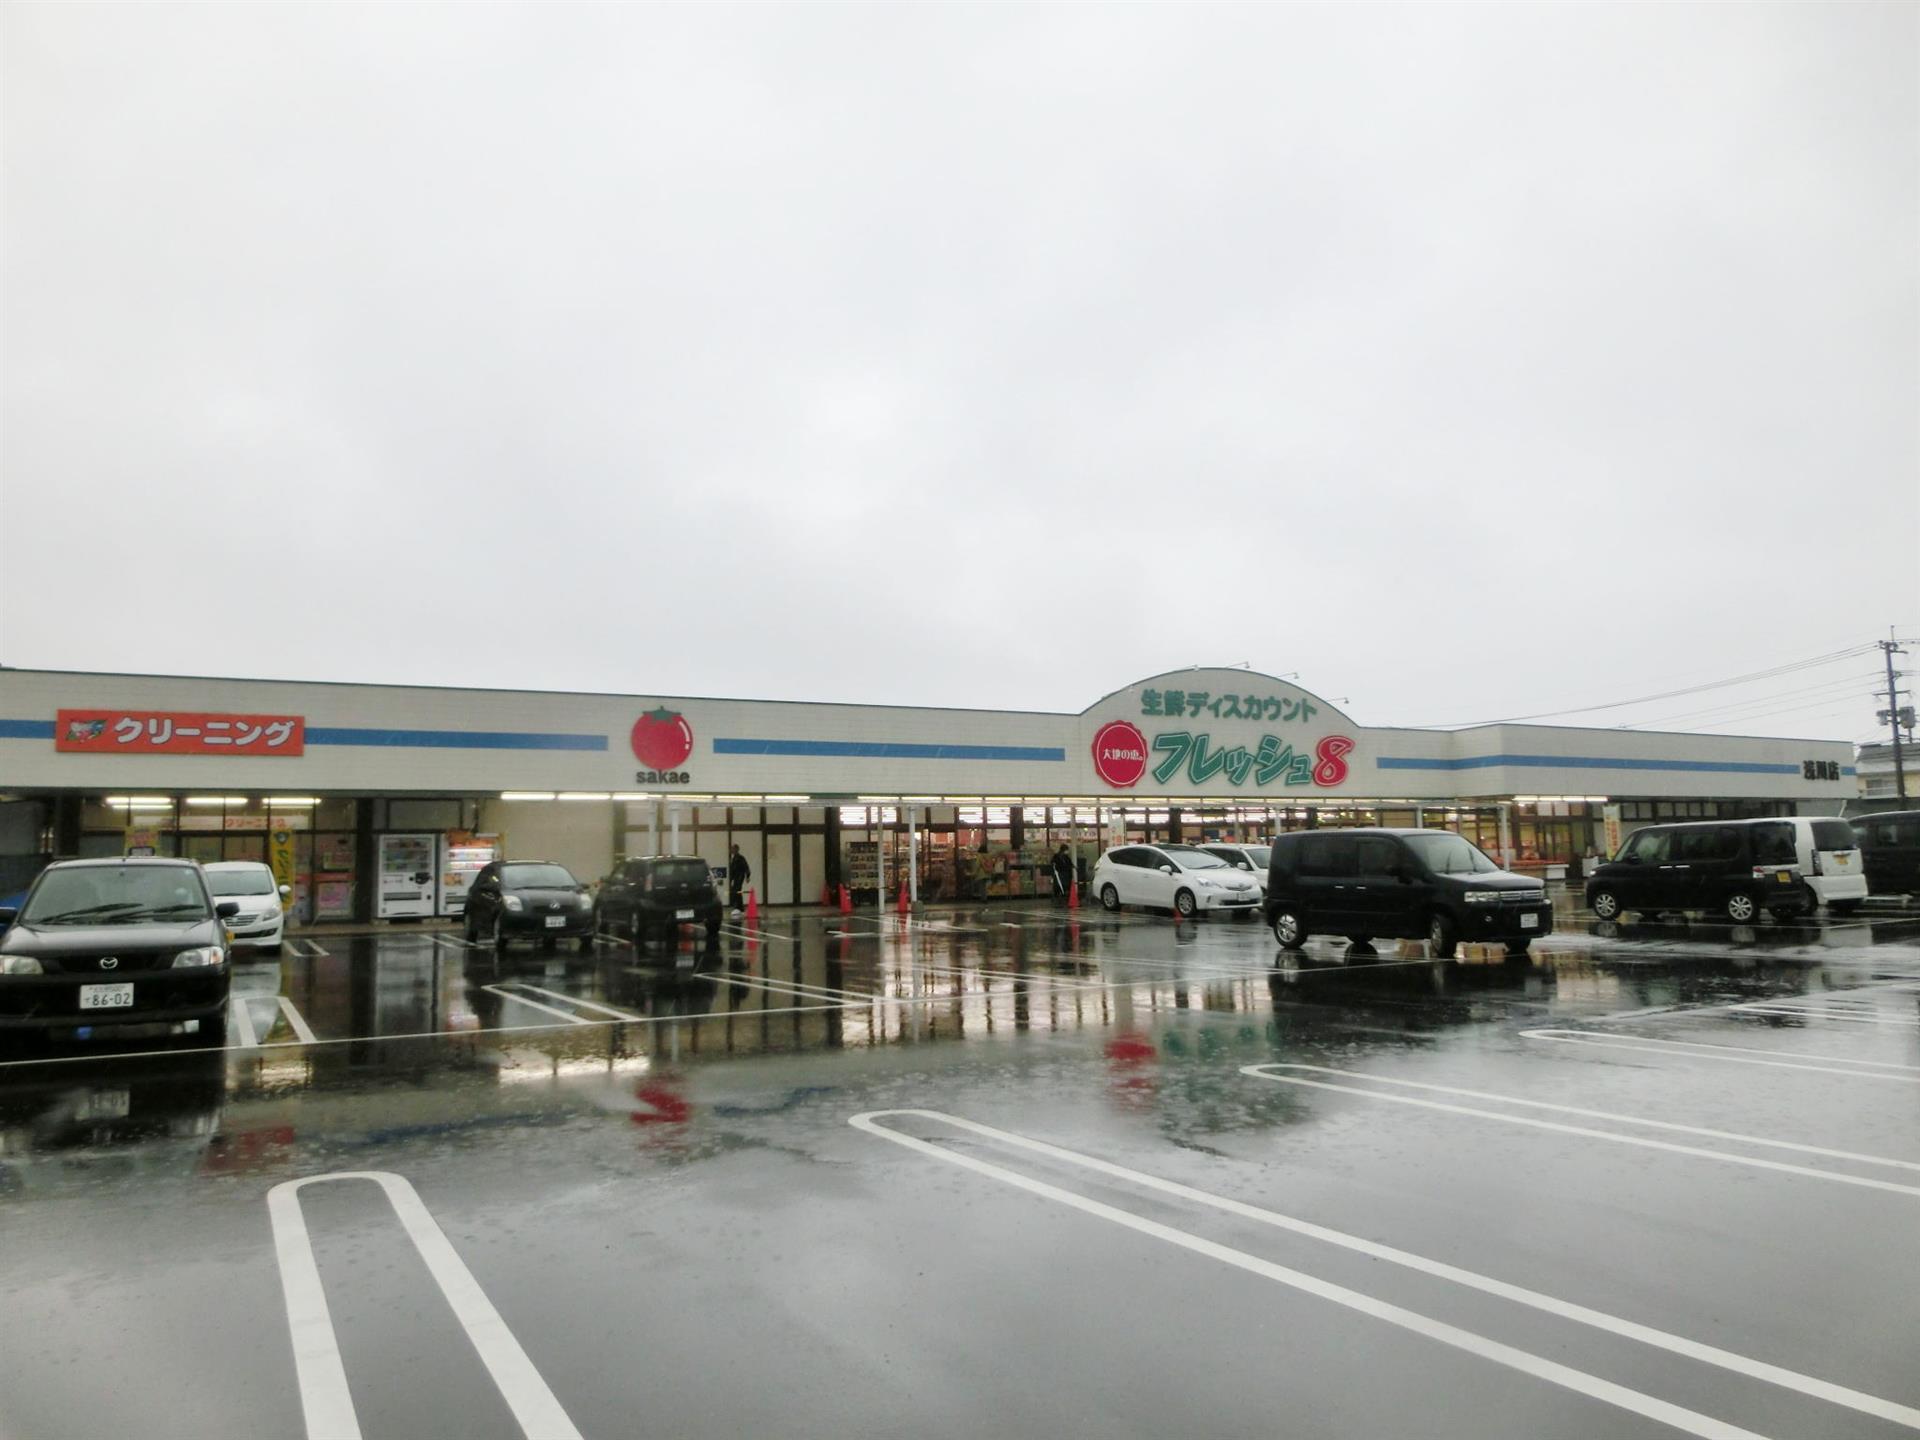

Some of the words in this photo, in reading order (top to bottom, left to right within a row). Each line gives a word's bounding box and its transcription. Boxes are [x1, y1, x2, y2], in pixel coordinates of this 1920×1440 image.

[114, 716, 296, 746] クリーニング
[636, 769, 690, 784] sakae
[92, 992, 131, 1007] 86-02
